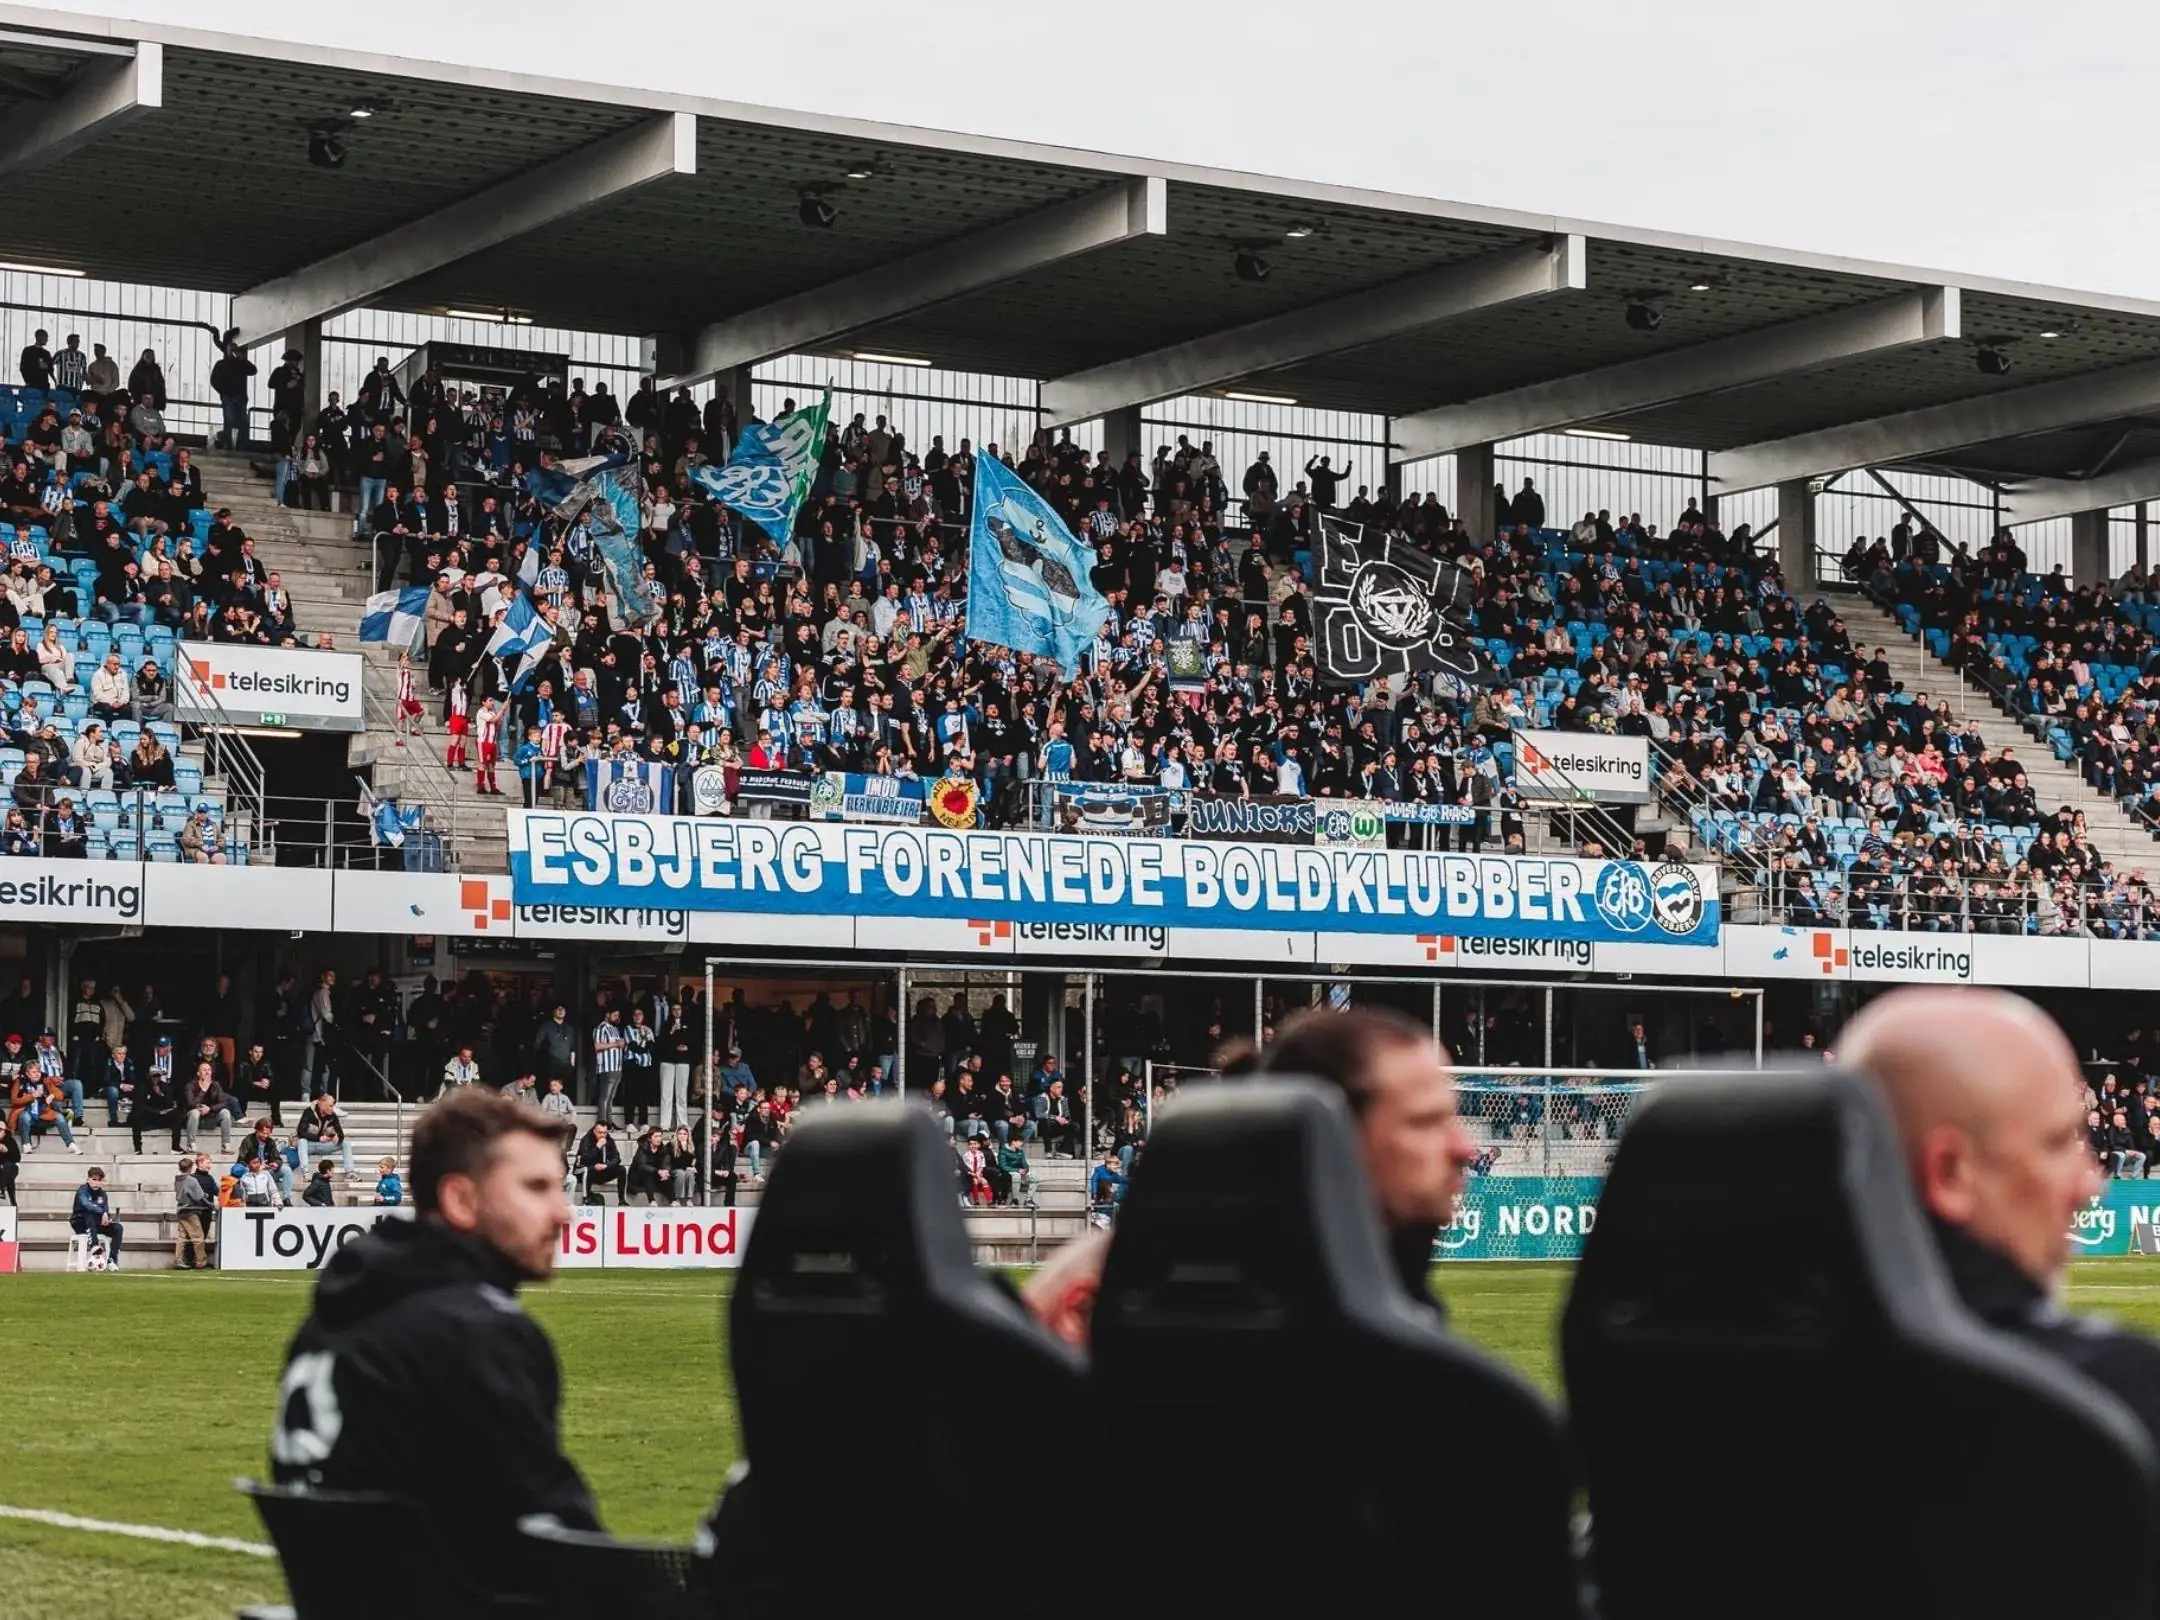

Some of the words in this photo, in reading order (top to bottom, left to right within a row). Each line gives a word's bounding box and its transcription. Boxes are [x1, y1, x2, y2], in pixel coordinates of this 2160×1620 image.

[229, 671, 349, 703] telesikring
[1552, 753, 1641, 780] telesikring
[1192, 798, 1316, 835] JUNIORS
[526, 816, 823, 893] ESBJERG
[844, 829, 1164, 907] FORENEDE
[1182, 845, 1586, 922] BOLDKLUBBER
[0, 875, 139, 918] esikring
[1852, 944, 1970, 978] telesikring
[617, 1209, 736, 1255] Lund
